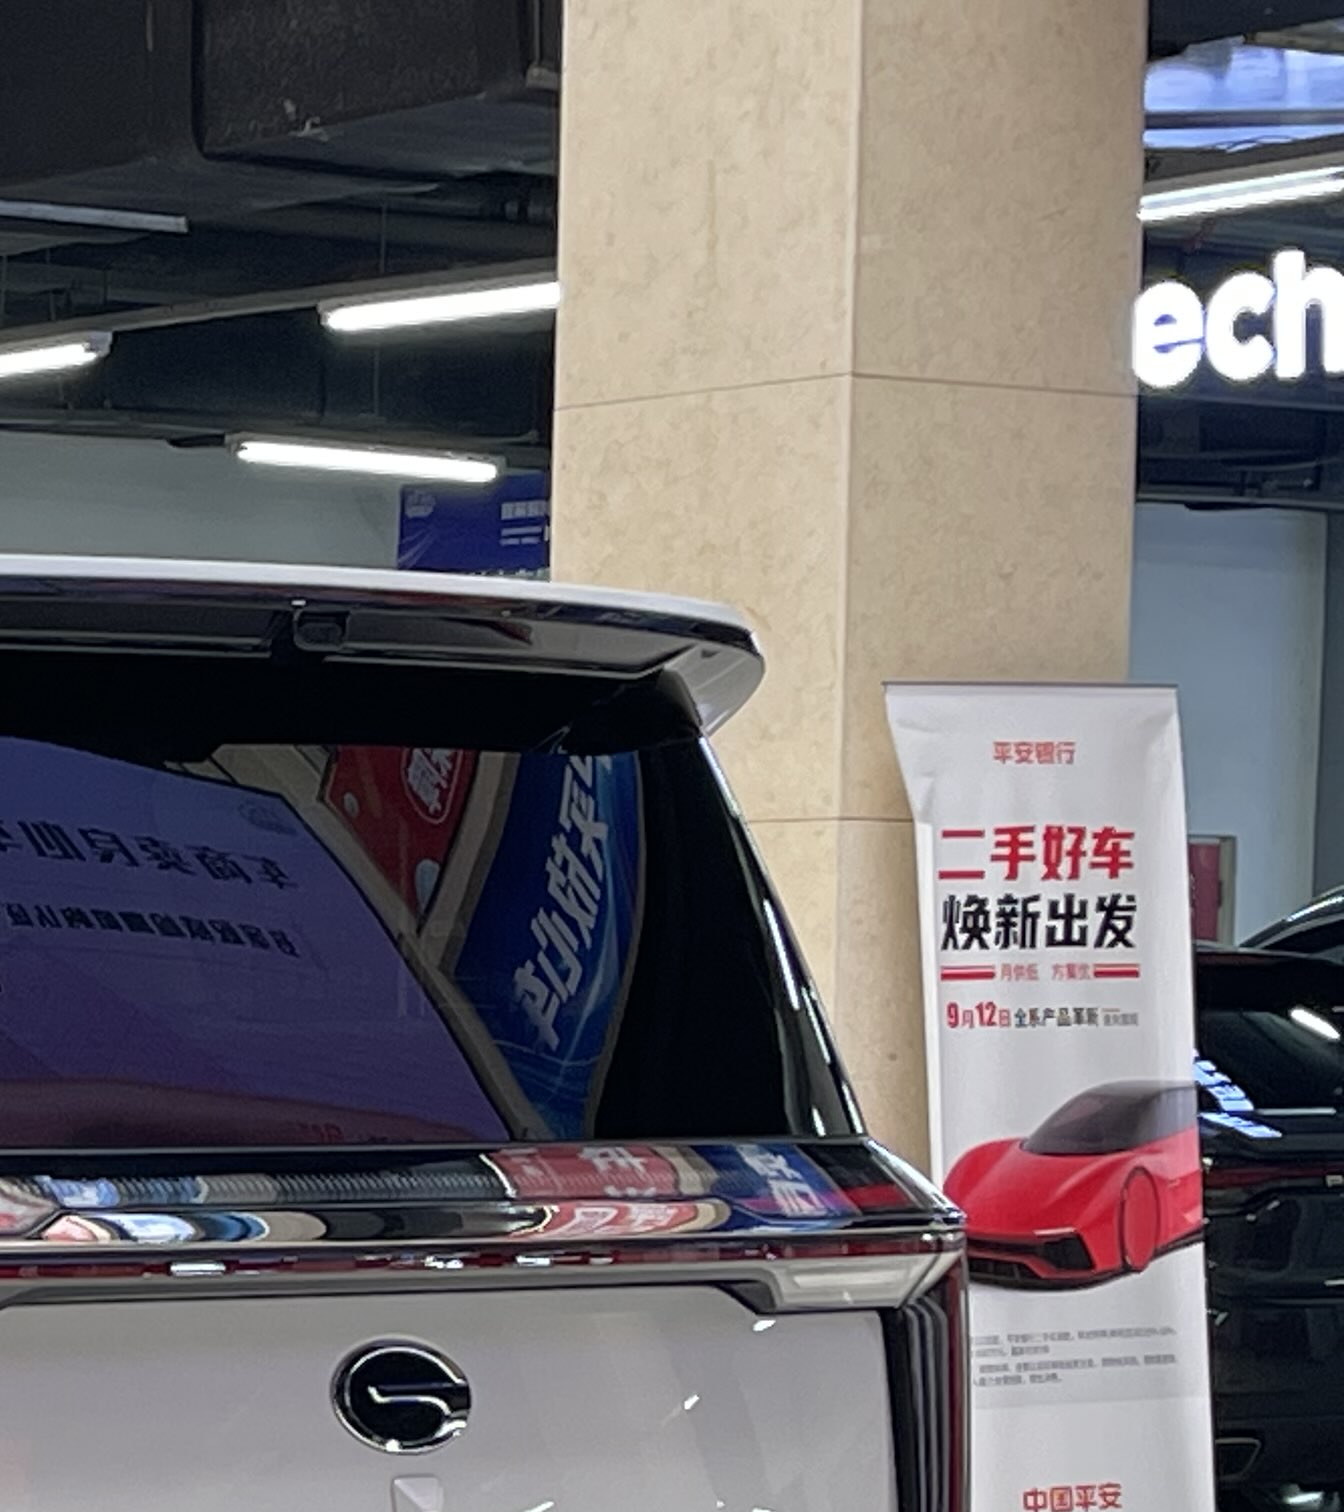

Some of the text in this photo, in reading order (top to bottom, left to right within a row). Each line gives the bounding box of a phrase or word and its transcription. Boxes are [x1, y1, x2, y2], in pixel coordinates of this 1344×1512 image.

[992, 740, 1076, 765] 平安银行
[938, 824, 1135, 881] 二手好车
[940, 893, 1137, 950] 焕新出发
